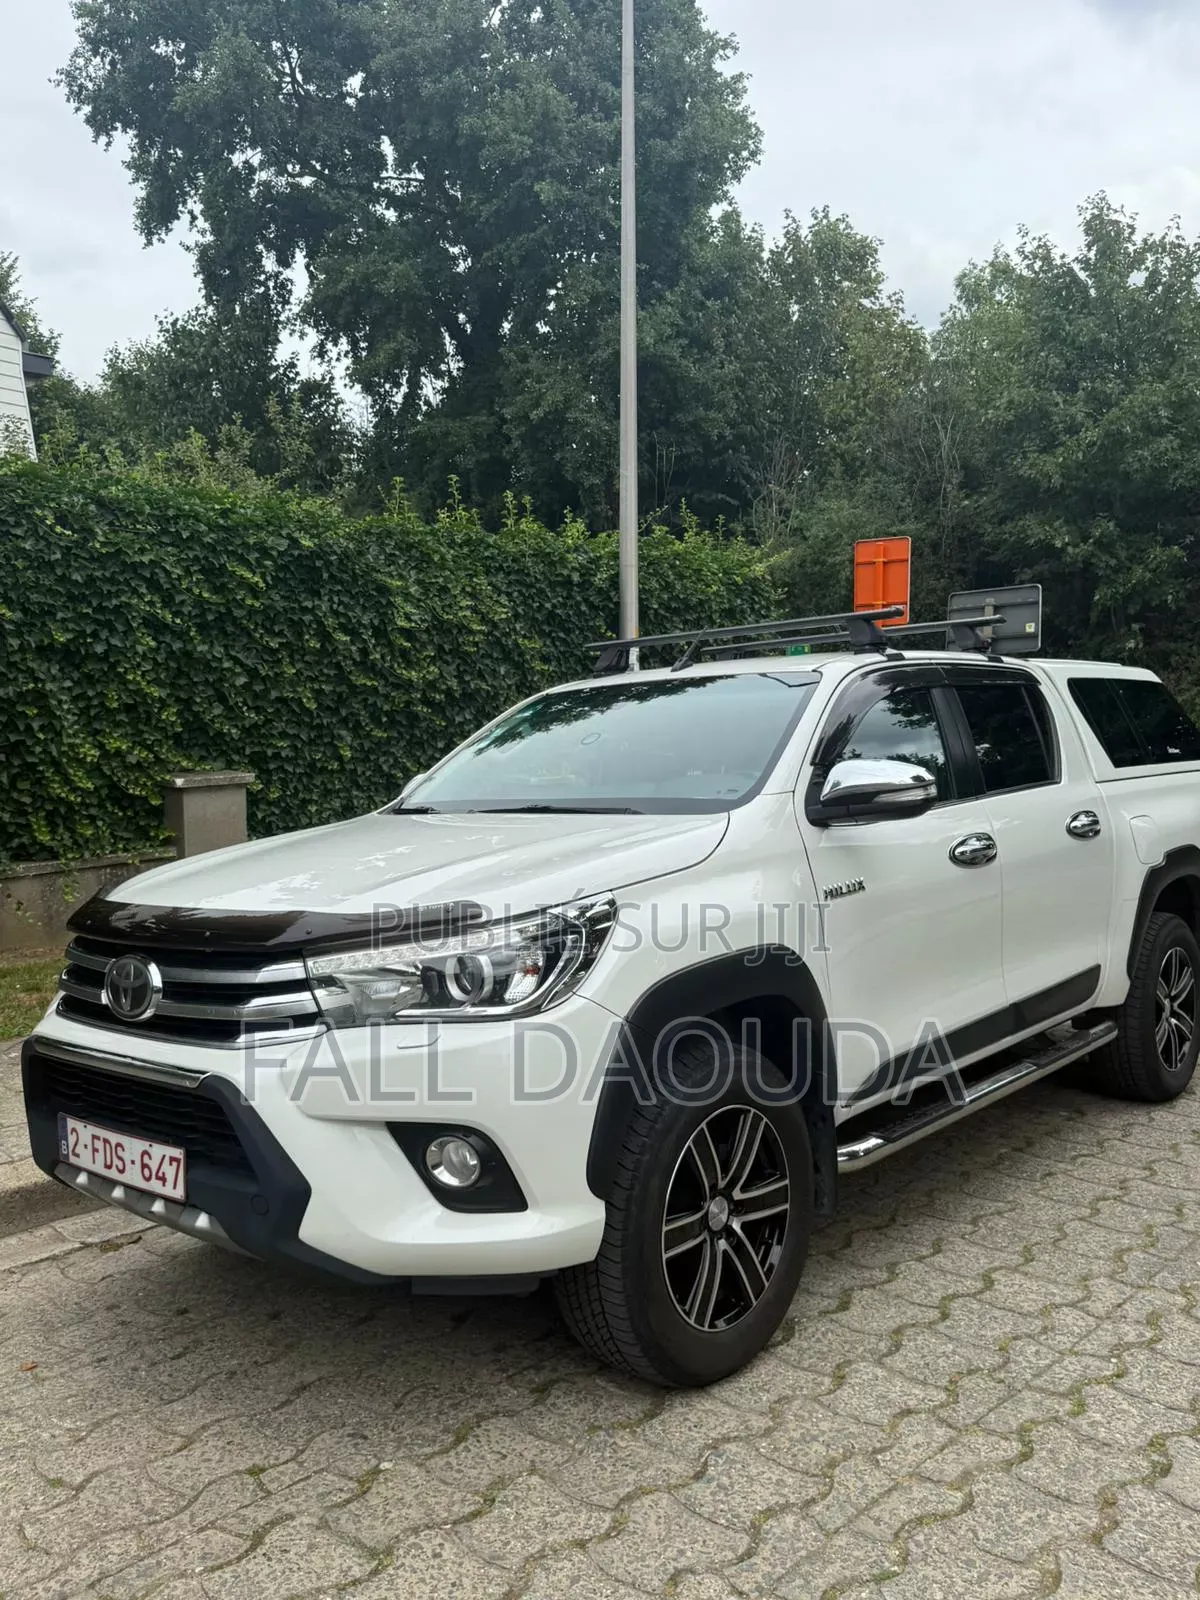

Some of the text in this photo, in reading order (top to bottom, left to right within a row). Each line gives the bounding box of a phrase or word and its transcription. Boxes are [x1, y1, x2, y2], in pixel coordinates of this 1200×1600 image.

[823, 877, 866, 901] HILUX
[61, 1140, 68, 1154] B
[70, 1127, 182, 1190] 2-FDS-647
